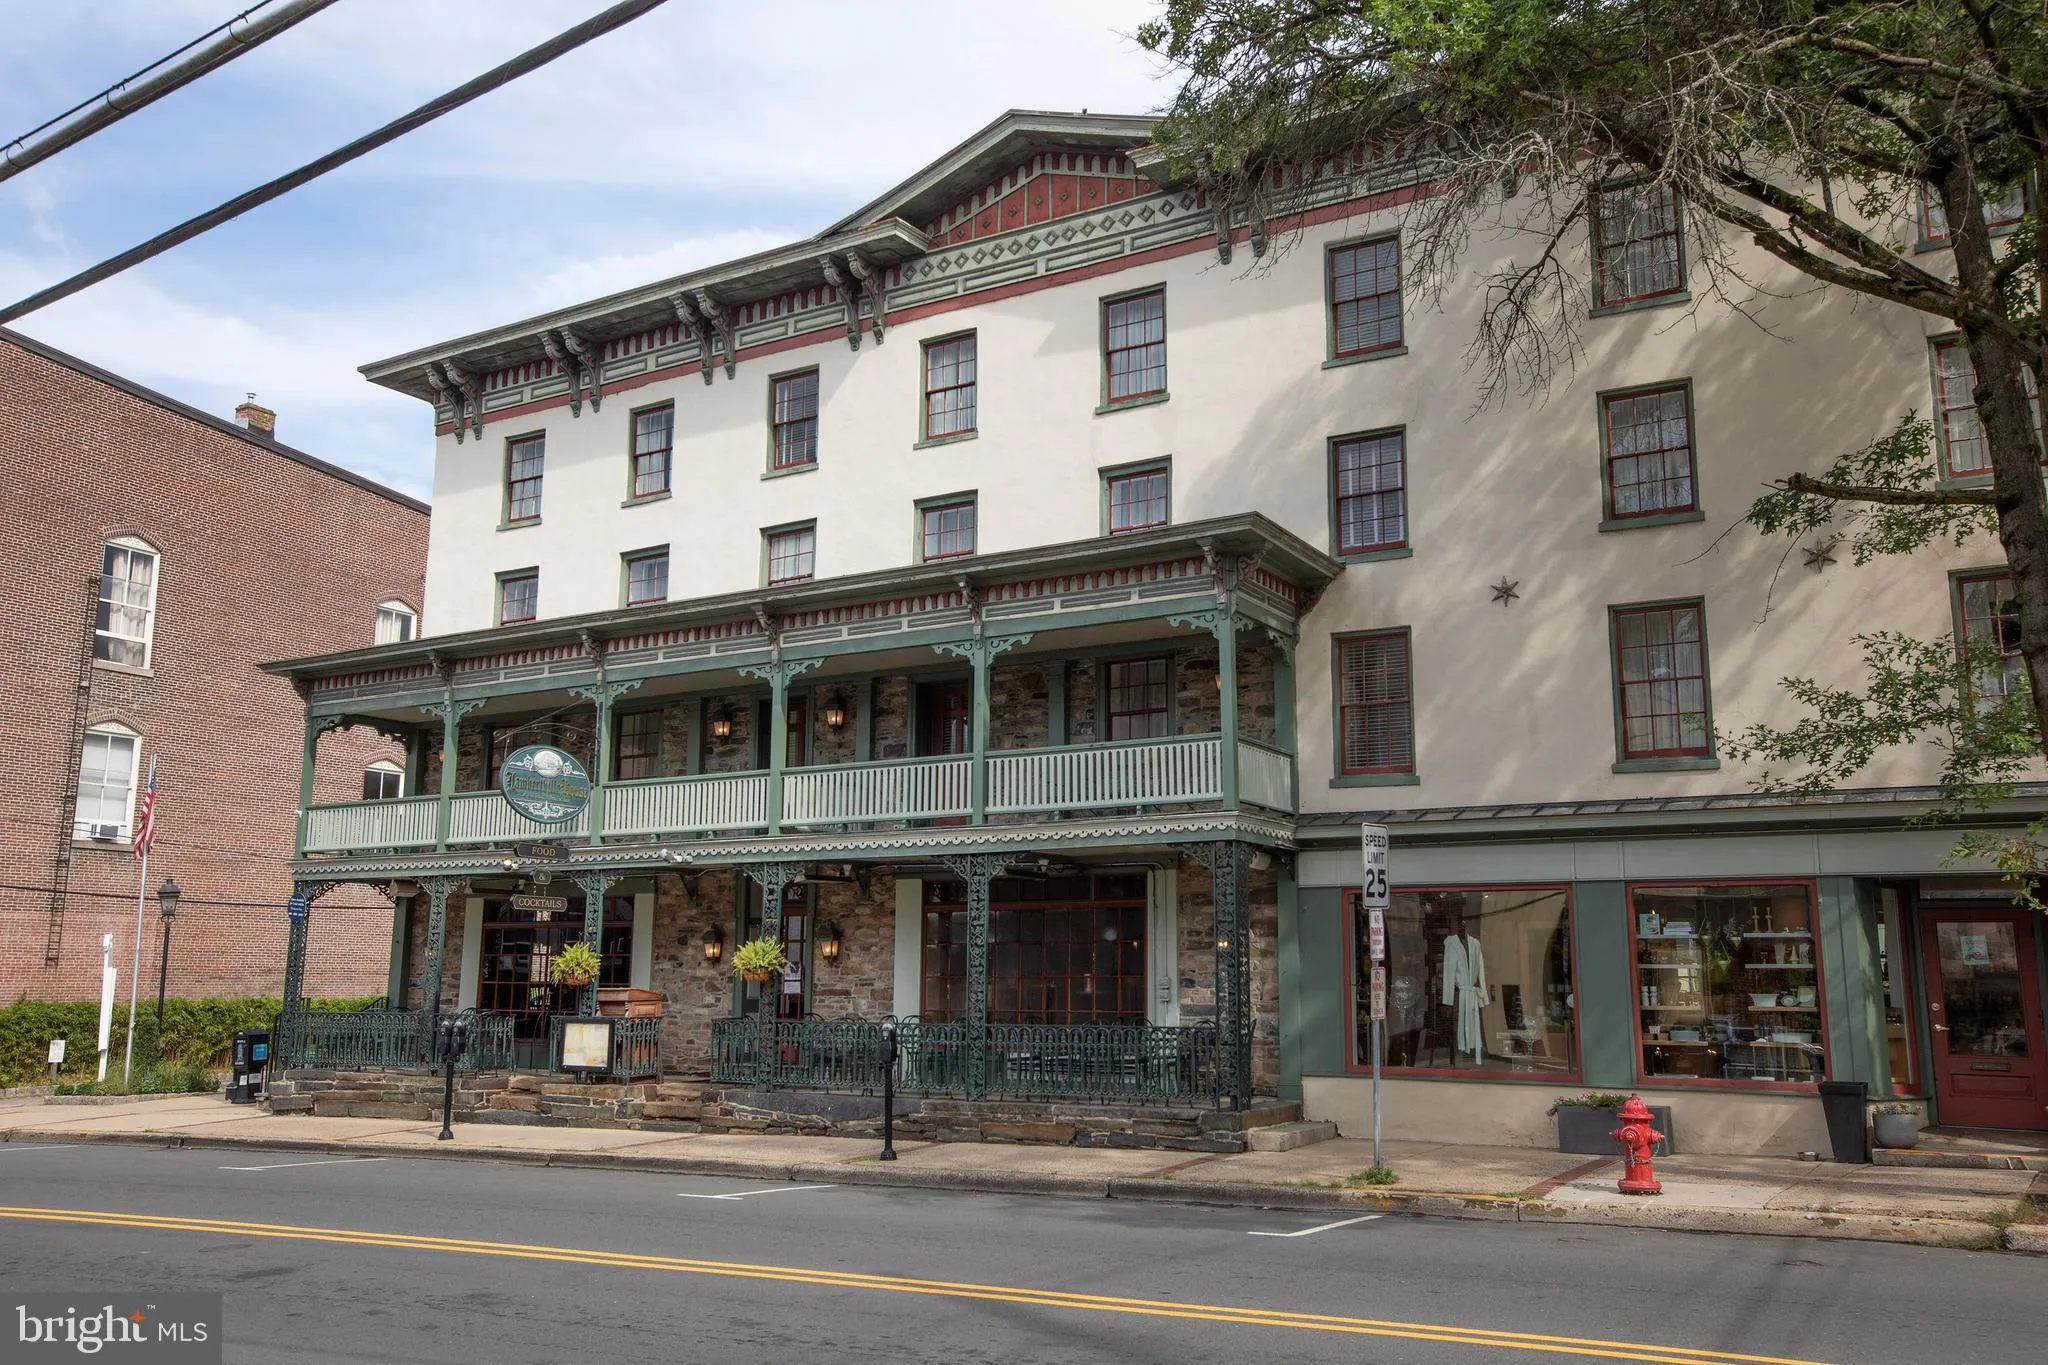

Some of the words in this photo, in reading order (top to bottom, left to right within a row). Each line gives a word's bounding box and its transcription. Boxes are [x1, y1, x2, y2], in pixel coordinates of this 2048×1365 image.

[1364, 834, 1387, 848] SPEED
[531, 846, 556, 857] FOOD
[1367, 851, 1385, 865] LIMIT
[538, 872, 546, 881] &
[1365, 867, 1387, 898] 25
[518, 898, 562, 909] COCKTAILS
